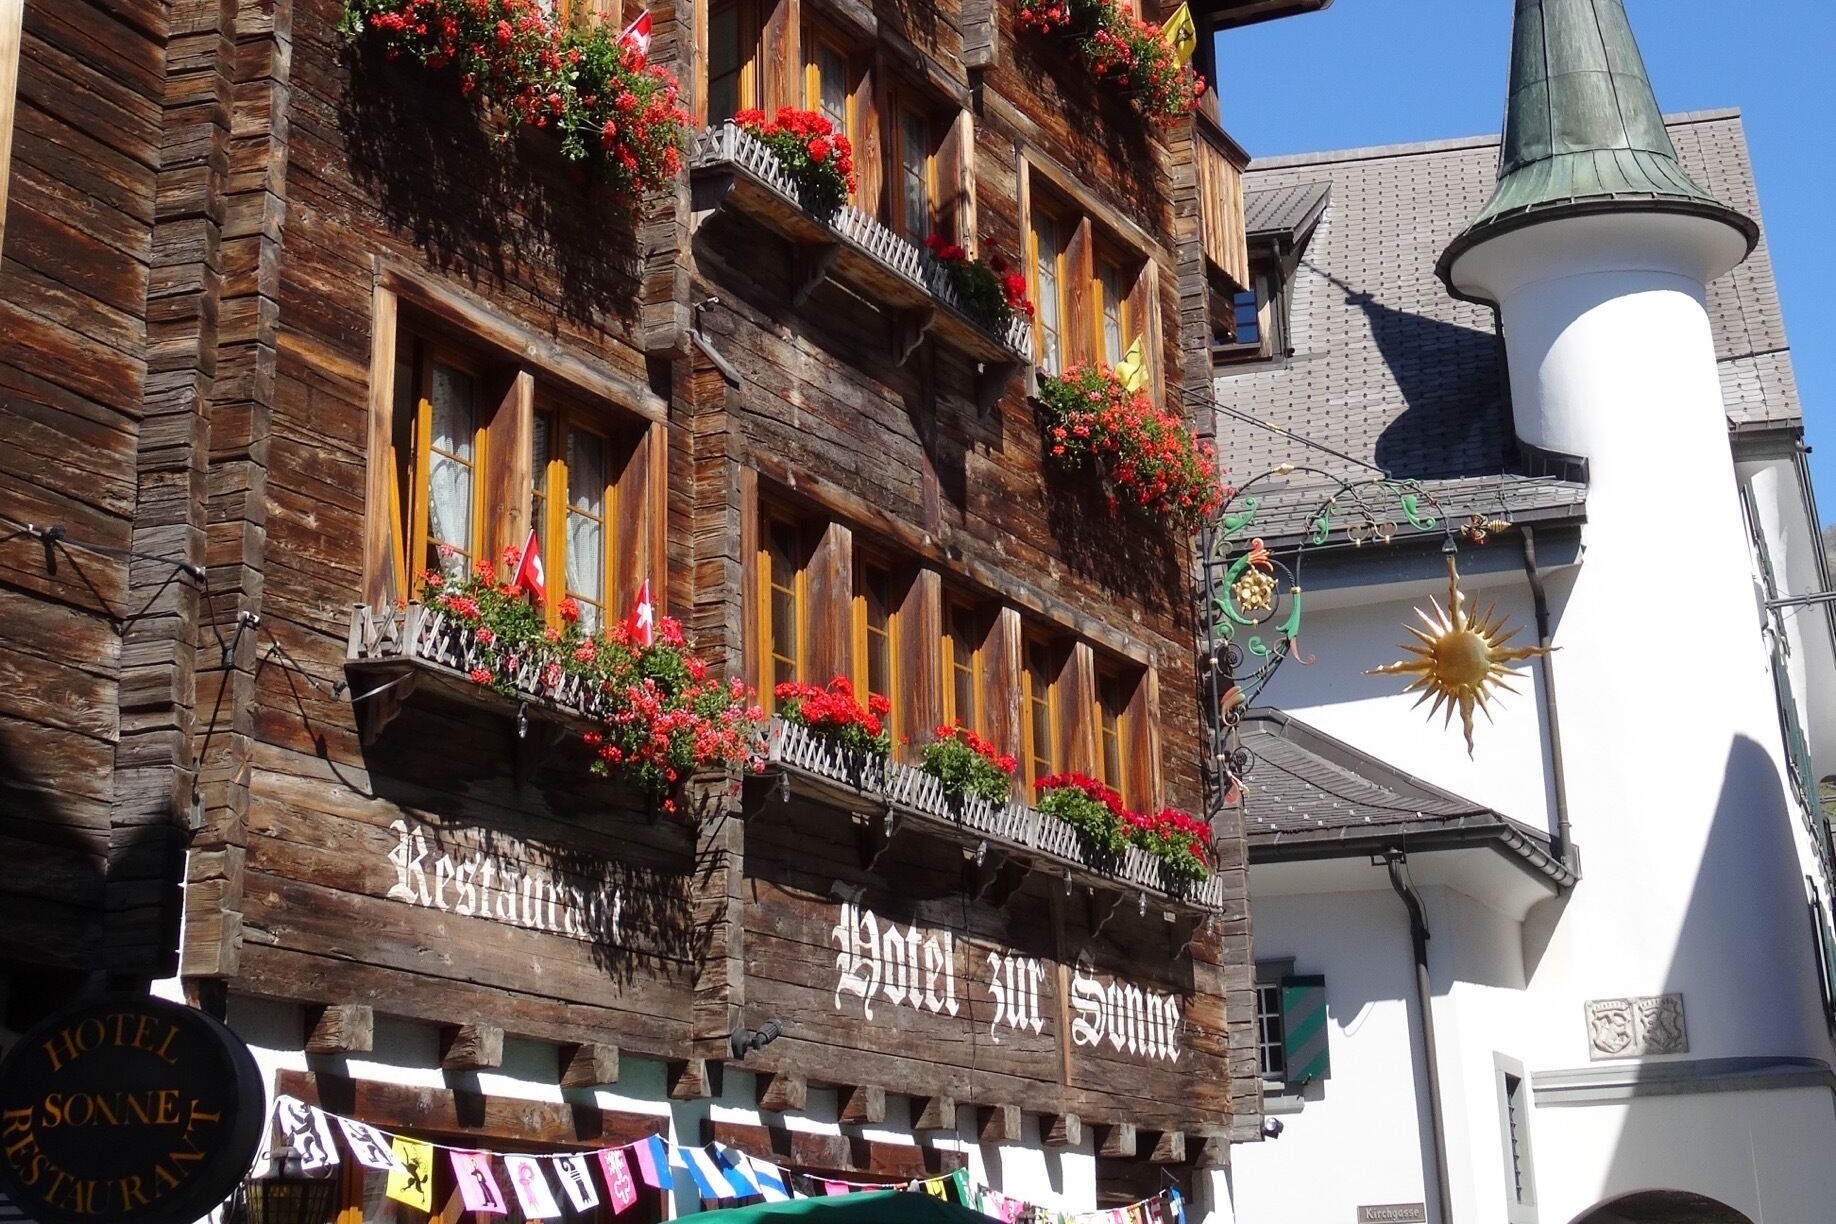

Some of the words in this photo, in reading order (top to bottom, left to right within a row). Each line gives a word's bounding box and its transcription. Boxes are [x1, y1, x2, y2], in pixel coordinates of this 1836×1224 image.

[831, 879, 960, 1021] Hotel
[986, 947, 1045, 1044] zur
[1071, 947, 1181, 1064] Sonne
[42, 1013, 180, 1072] HOTEL
[41, 1089, 181, 1128] SONNE
[2, 1098, 221, 1216] RESTAURANT
[1365, 1207, 1420, 1221] Kirchgasse
